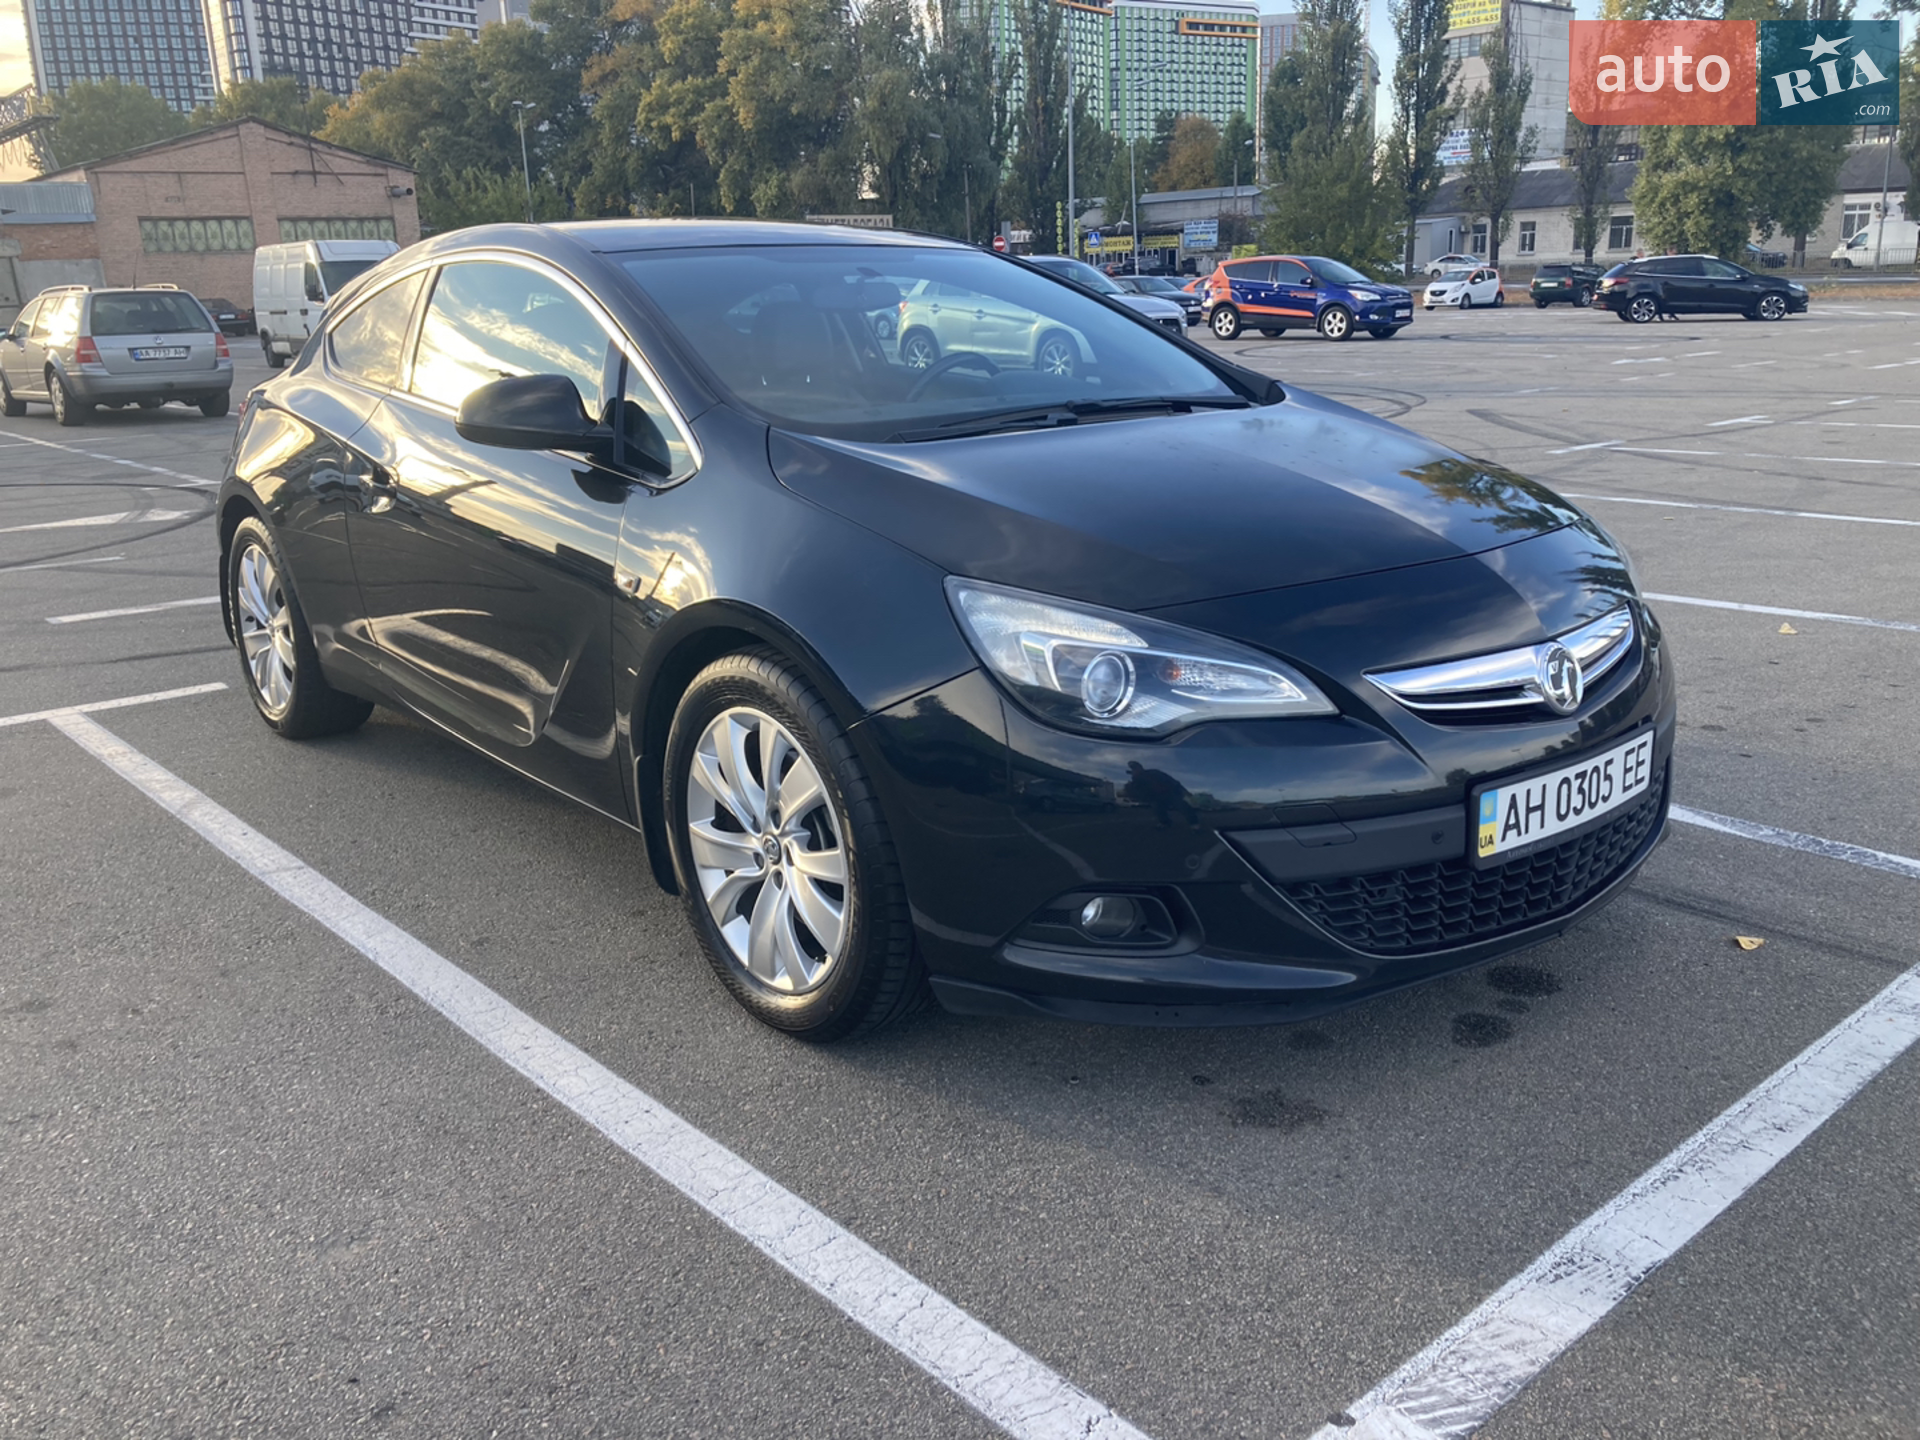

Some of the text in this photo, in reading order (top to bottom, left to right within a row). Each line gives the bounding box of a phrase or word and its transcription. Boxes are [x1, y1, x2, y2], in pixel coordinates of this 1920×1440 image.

[1501, 740, 1648, 843] AH 0305 EE
[1479, 834, 1494, 848] UA
